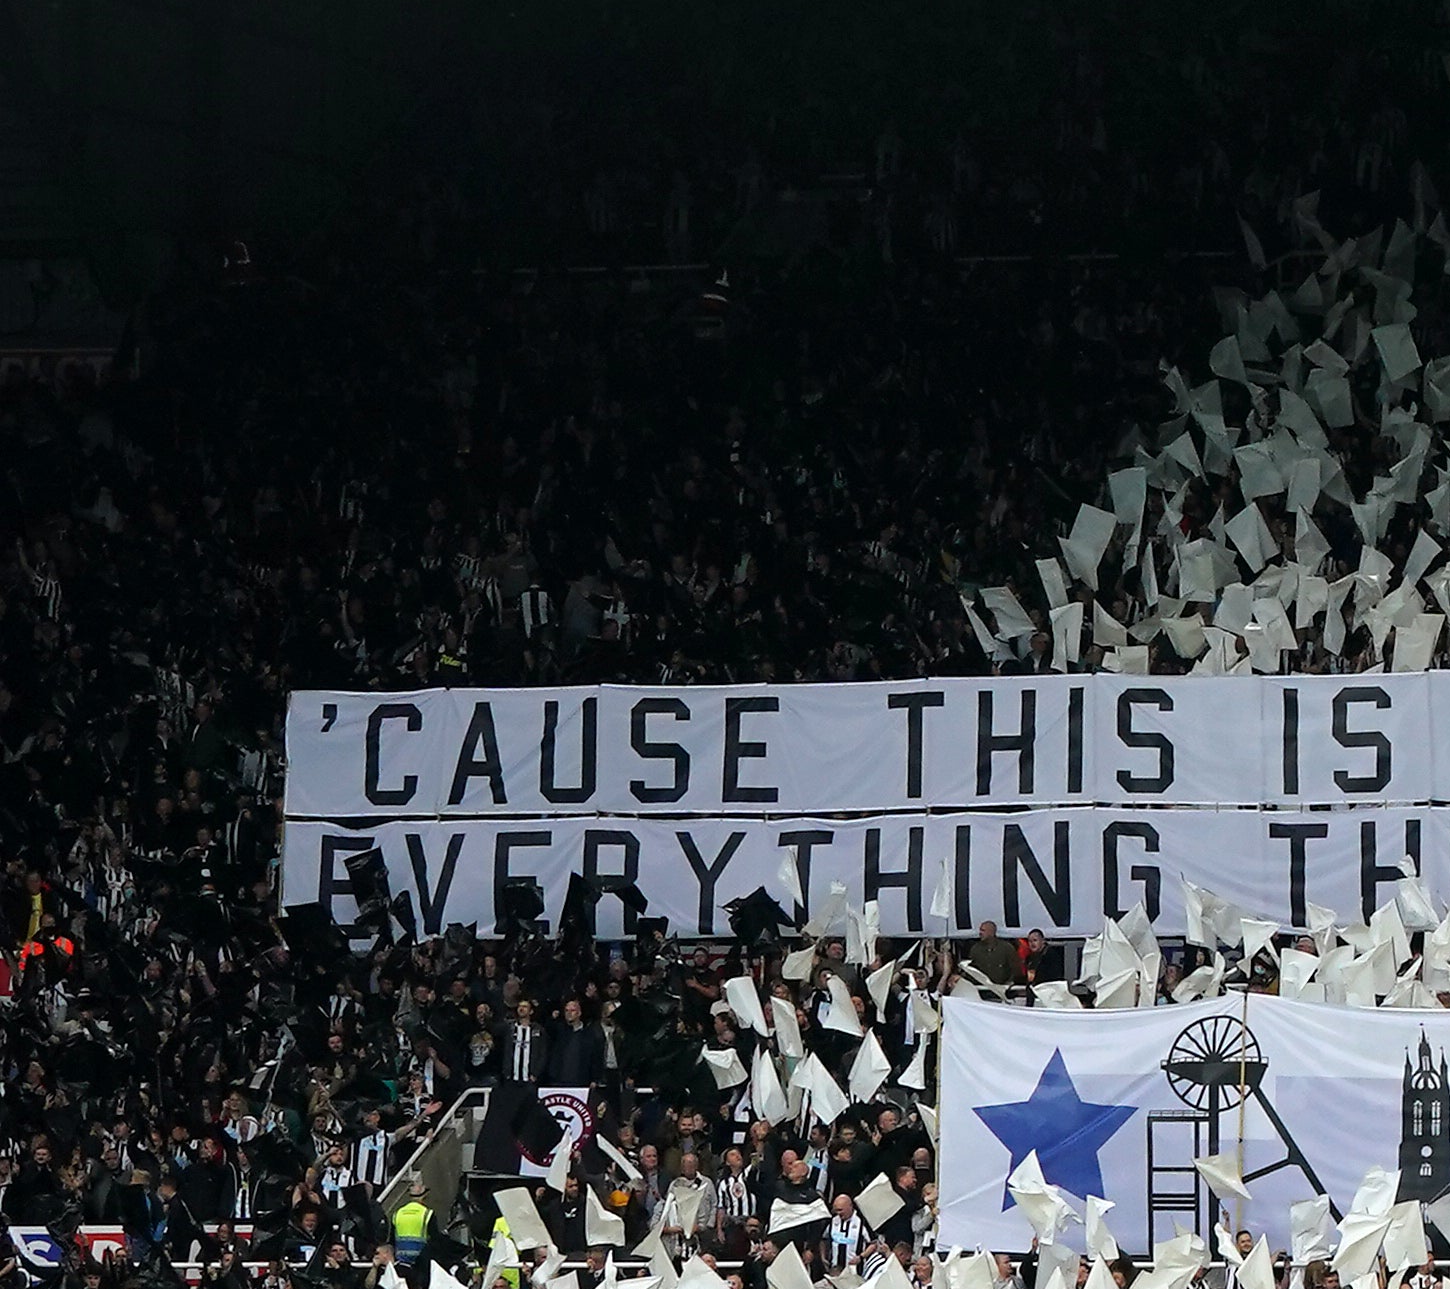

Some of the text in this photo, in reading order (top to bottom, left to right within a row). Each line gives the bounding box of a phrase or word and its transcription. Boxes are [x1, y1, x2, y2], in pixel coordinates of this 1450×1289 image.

[320, 696, 780, 806] 'CAUSE
[888, 687, 1174, 799] THIS
[1282, 686, 1392, 795] IS
[318, 821, 1161, 939] EVERYTHING
